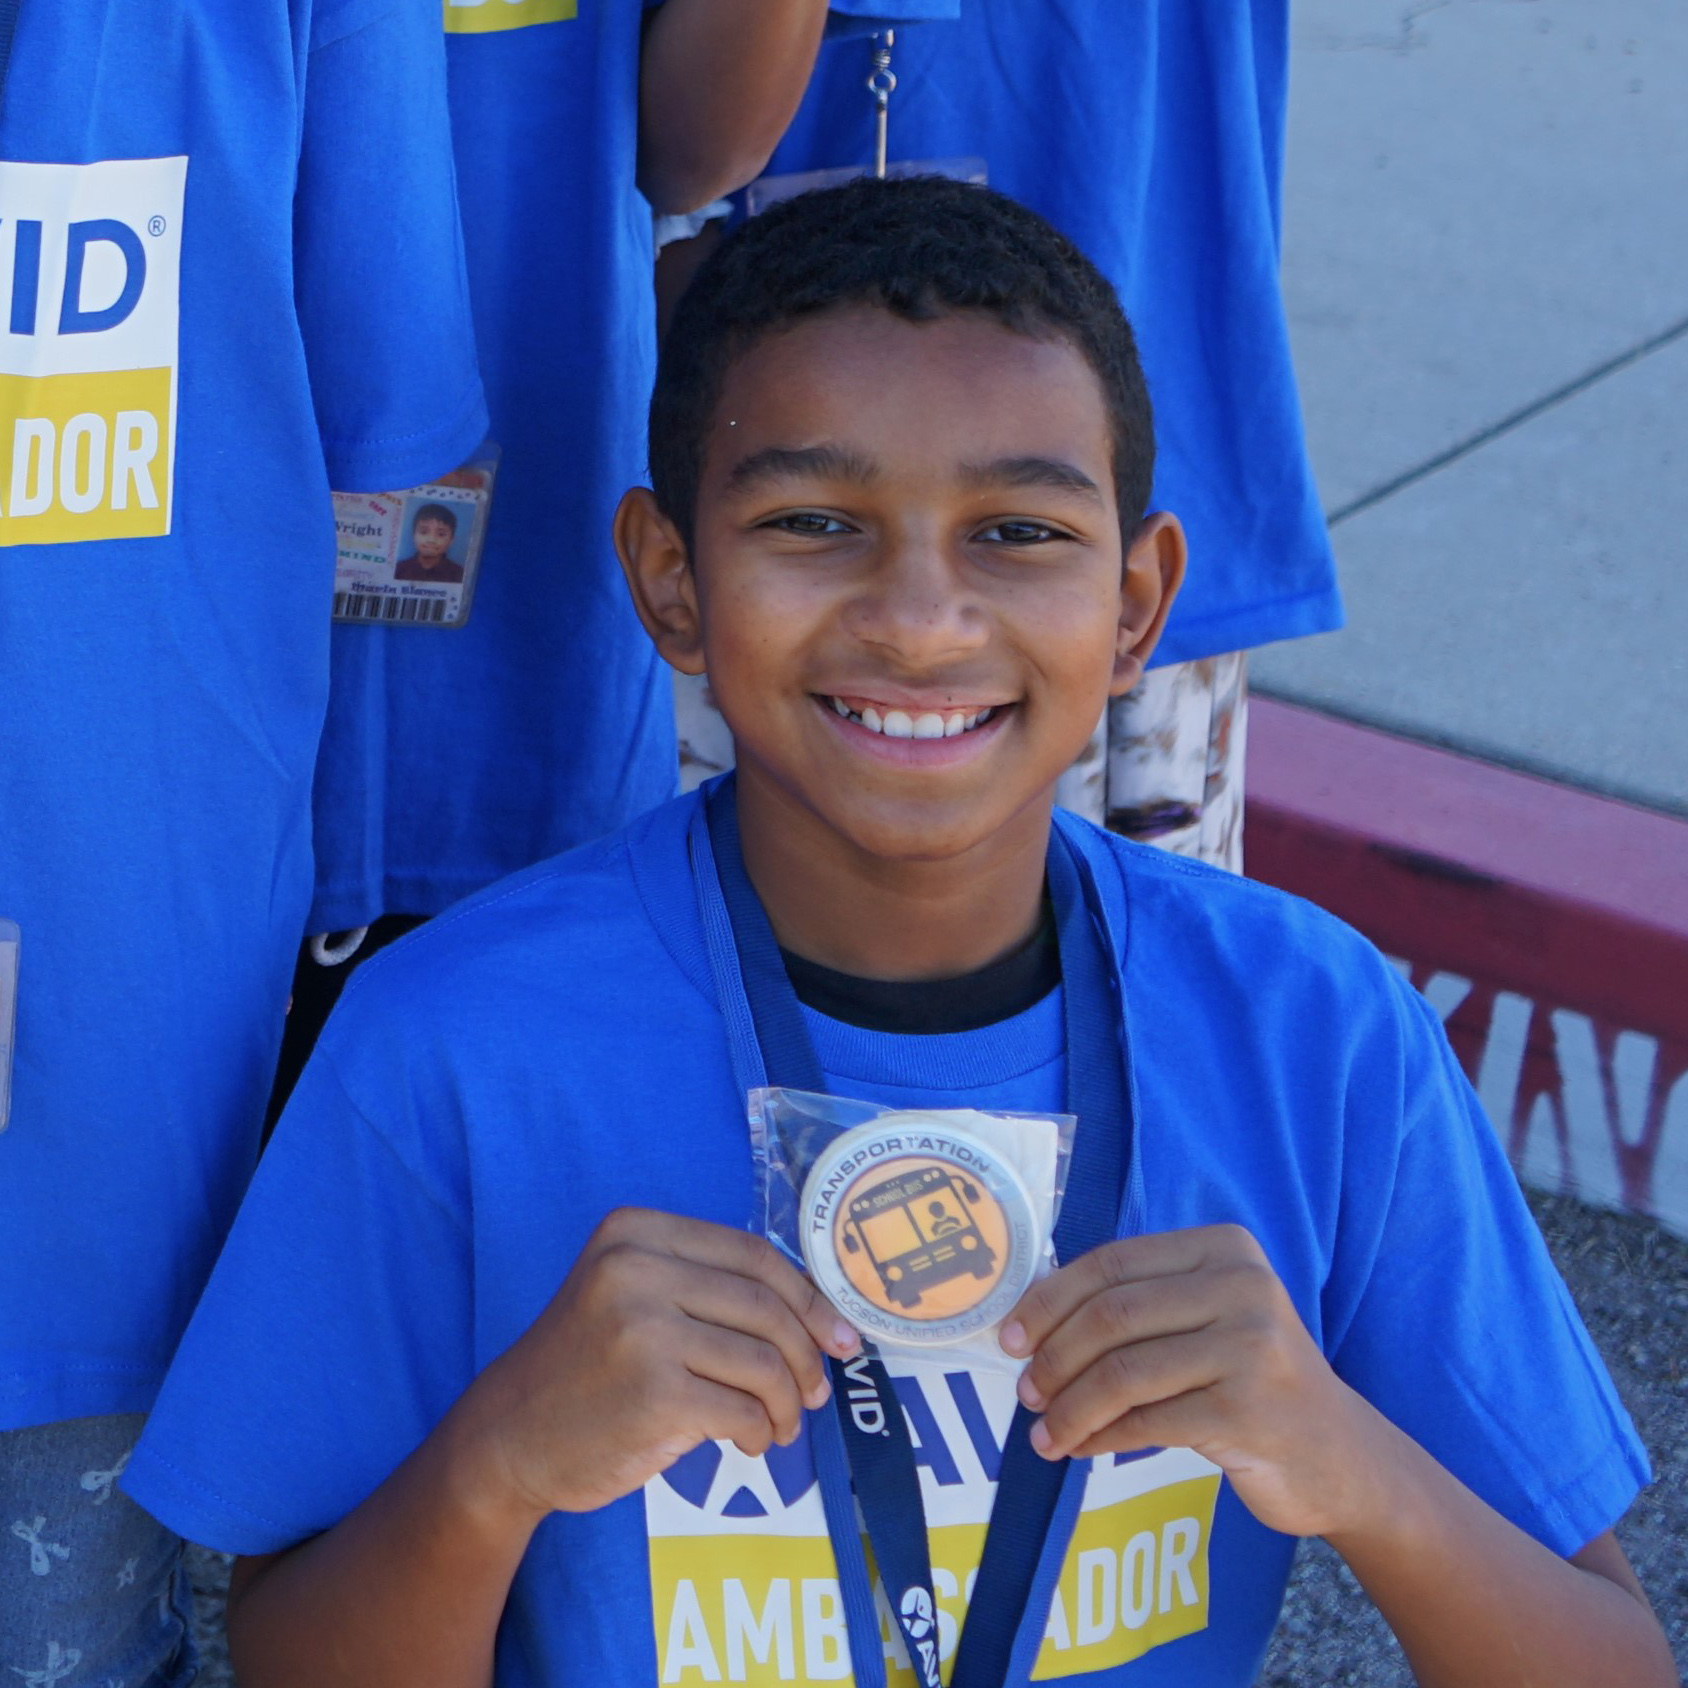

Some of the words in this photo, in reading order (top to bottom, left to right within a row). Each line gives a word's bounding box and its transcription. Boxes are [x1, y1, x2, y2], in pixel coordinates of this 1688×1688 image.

[812, 1136, 991, 1234] TRANSPORTATION
[872, 1186, 906, 1209] SCHOOL
[837, 1286, 892, 1333] TUCSON
[894, 1322, 957, 1339] UNIFIED
[842, 1357, 886, 1434] VID
